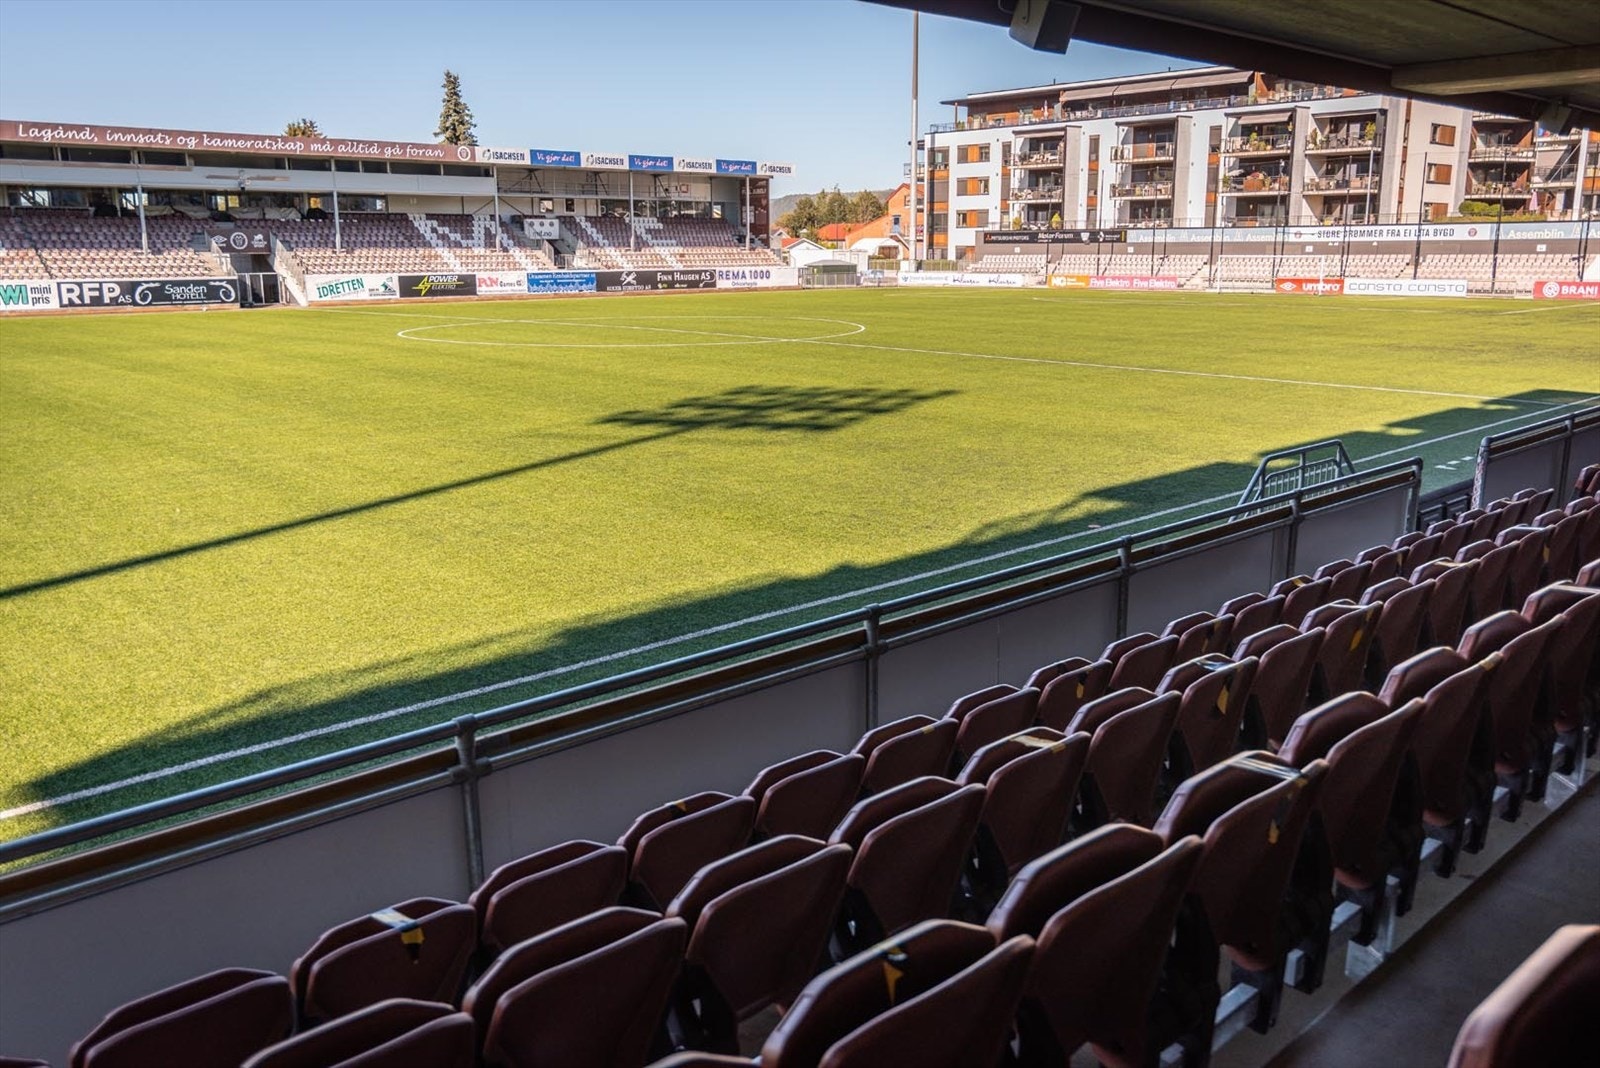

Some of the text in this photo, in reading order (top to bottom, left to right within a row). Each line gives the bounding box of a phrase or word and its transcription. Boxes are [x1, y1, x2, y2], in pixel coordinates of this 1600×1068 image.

[18, 124, 446, 158] Lagånd, innsats og kameratskap må alltid gå foran
[492, 150, 526, 161] ISACHSEN
[536, 152, 545, 161] Vi
[594, 156, 624, 166] ISACHSEN
[685, 161, 713, 170] ISACHSEN
[767, 165, 792, 174] ISACHSEN
[1191, 233, 1230, 242] Assembin
[1317, 230, 1341, 238] STORE
[1386, 229, 1401, 237] FRA
[1403, 228, 1412, 237] EI
[1414, 228, 1430, 237] LTA
[1433, 228, 1455, 237] BYGD
[1508, 228, 1565, 239] Assemblin
[429, 275, 459, 283] POWER
[701, 272, 711, 281] AS
[718, 270, 771, 281] REMA 1000
[30, 284, 51, 295] mini
[165, 284, 207, 295] Sanden
[316, 278, 365, 298] IDRETTEN
[1302, 281, 1341, 292] umbro
[60, 283, 132, 304] RFP AS
[31, 294, 51, 307] pris
